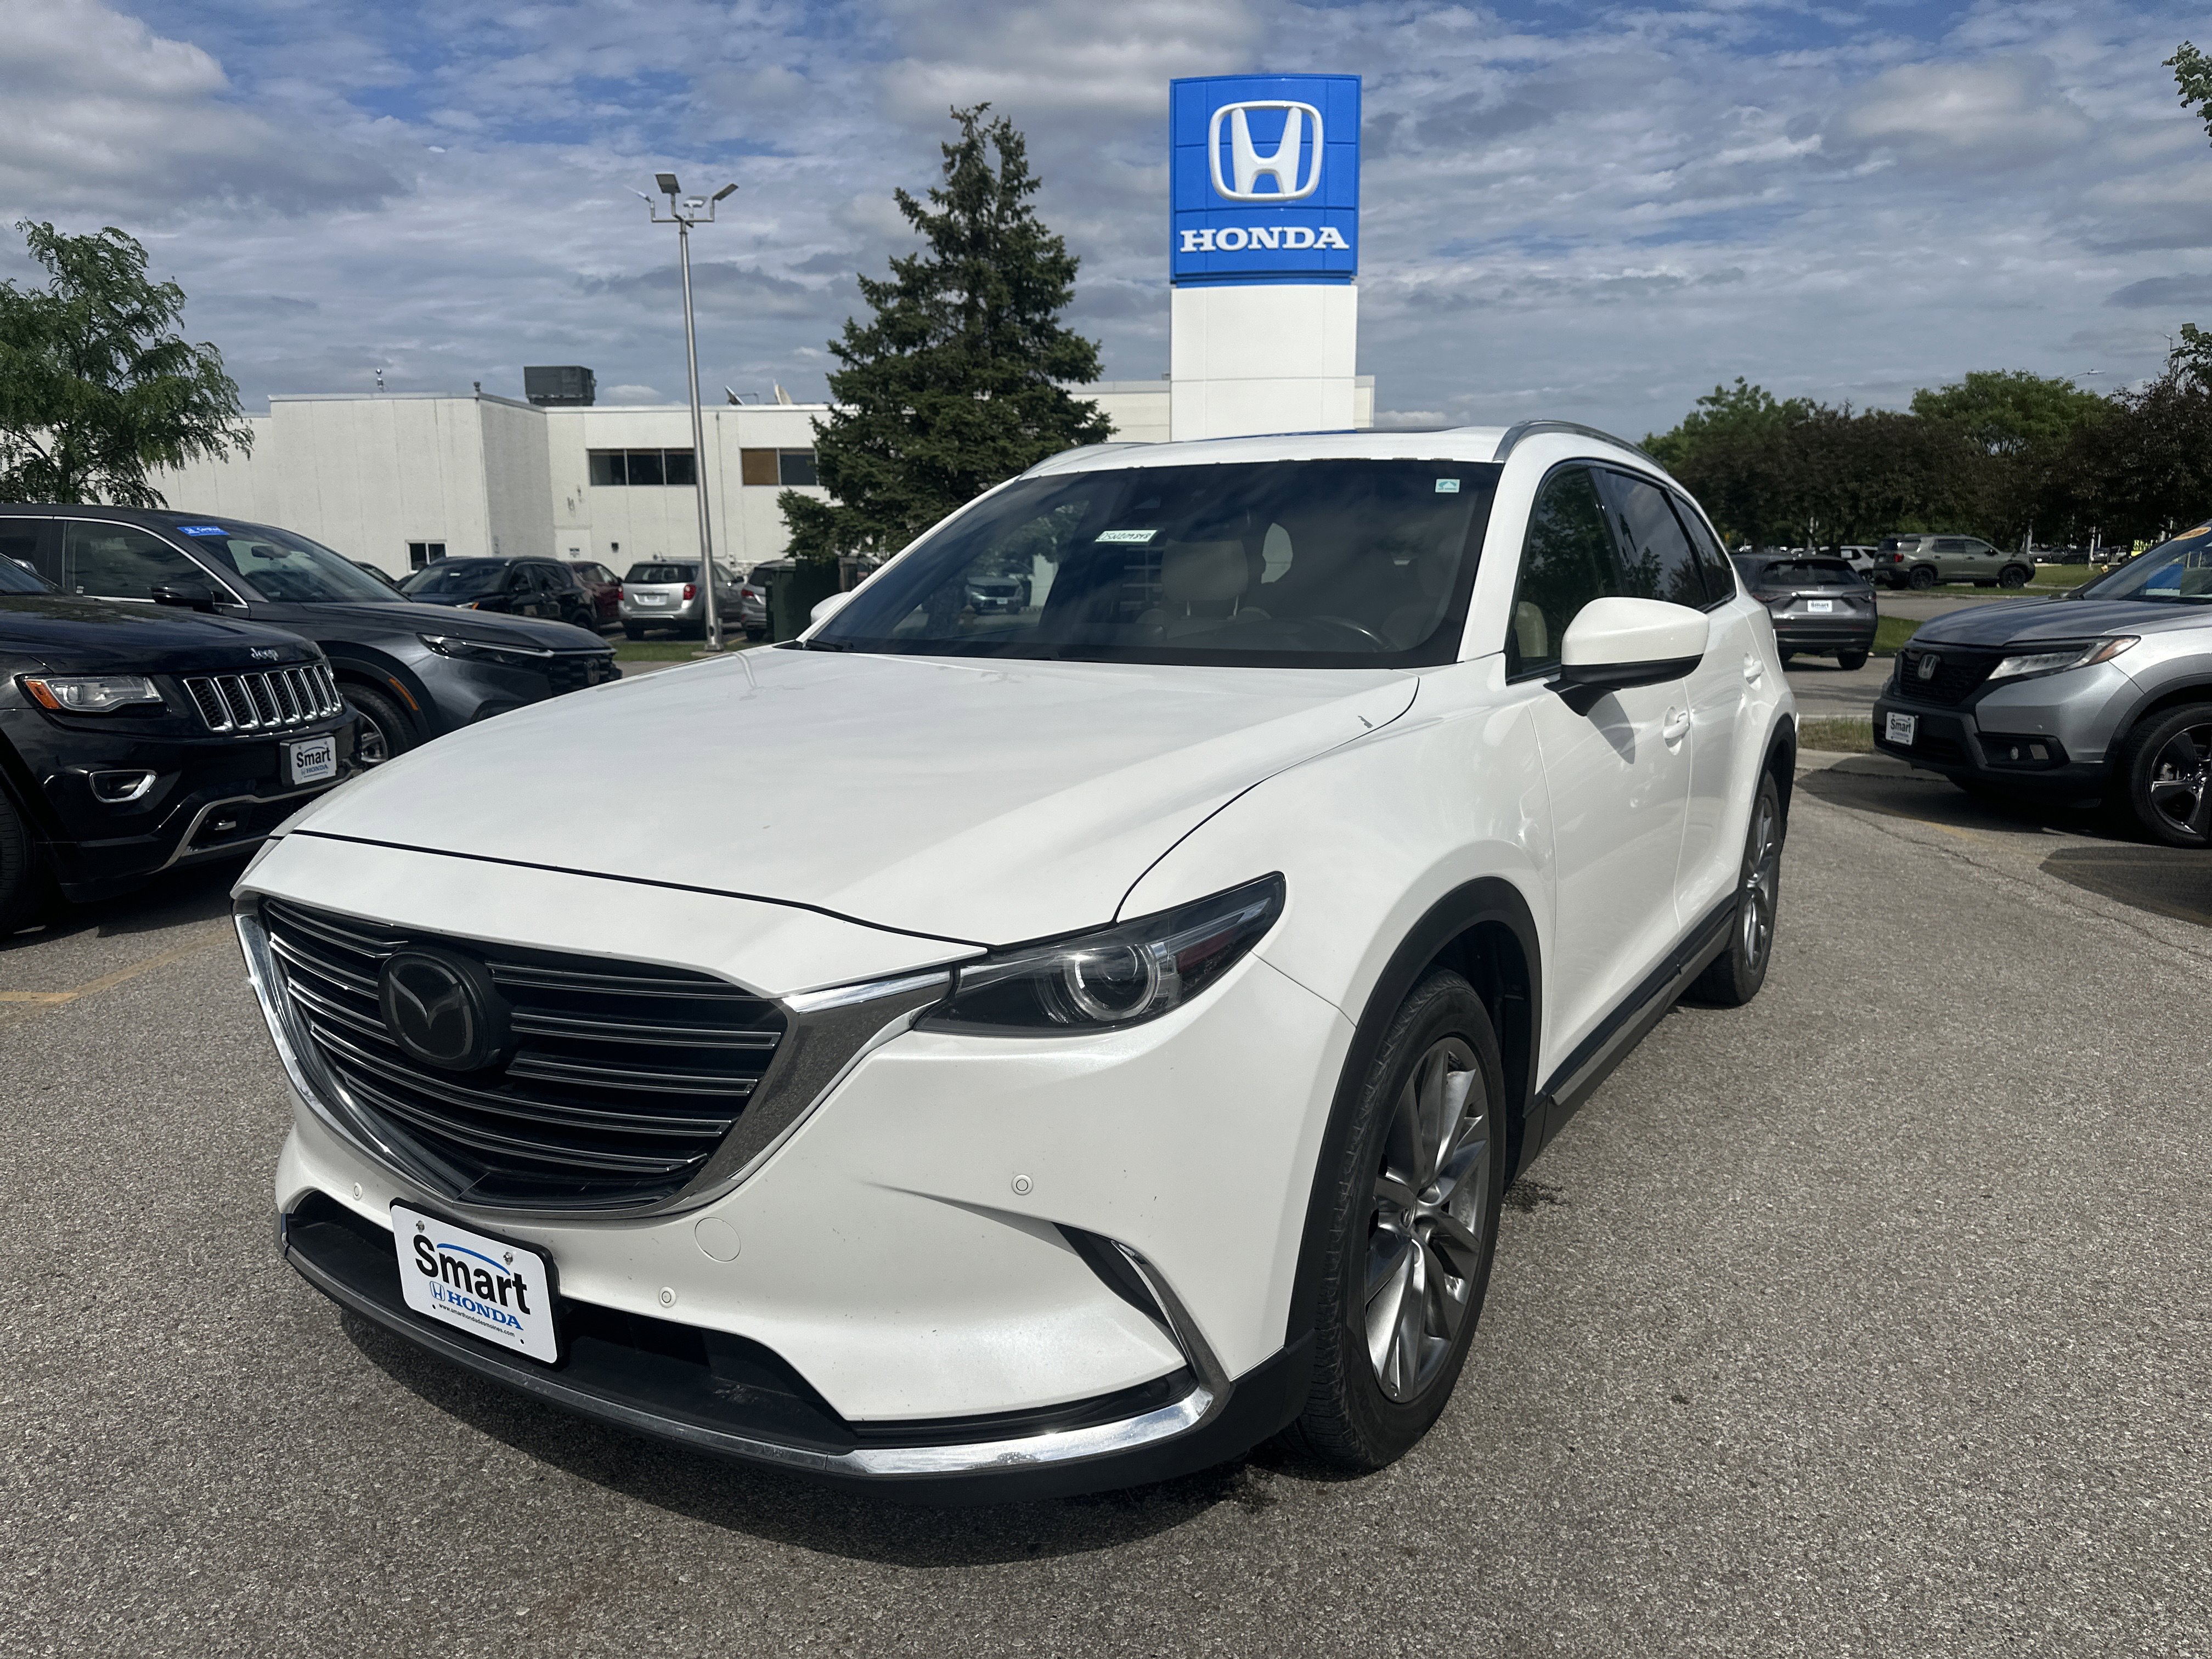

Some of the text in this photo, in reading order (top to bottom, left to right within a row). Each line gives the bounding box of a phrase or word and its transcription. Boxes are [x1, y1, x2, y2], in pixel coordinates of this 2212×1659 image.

[1180, 227, 1350, 252] HONDA
[251, 647, 279, 661] Jeep
[1891, 718, 1911, 733] Smart
[297, 747, 331, 768] Smart
[306, 764, 329, 774] HONDA
[413, 1234, 531, 1316] Smart
[447, 1290, 524, 1331] HONDA
